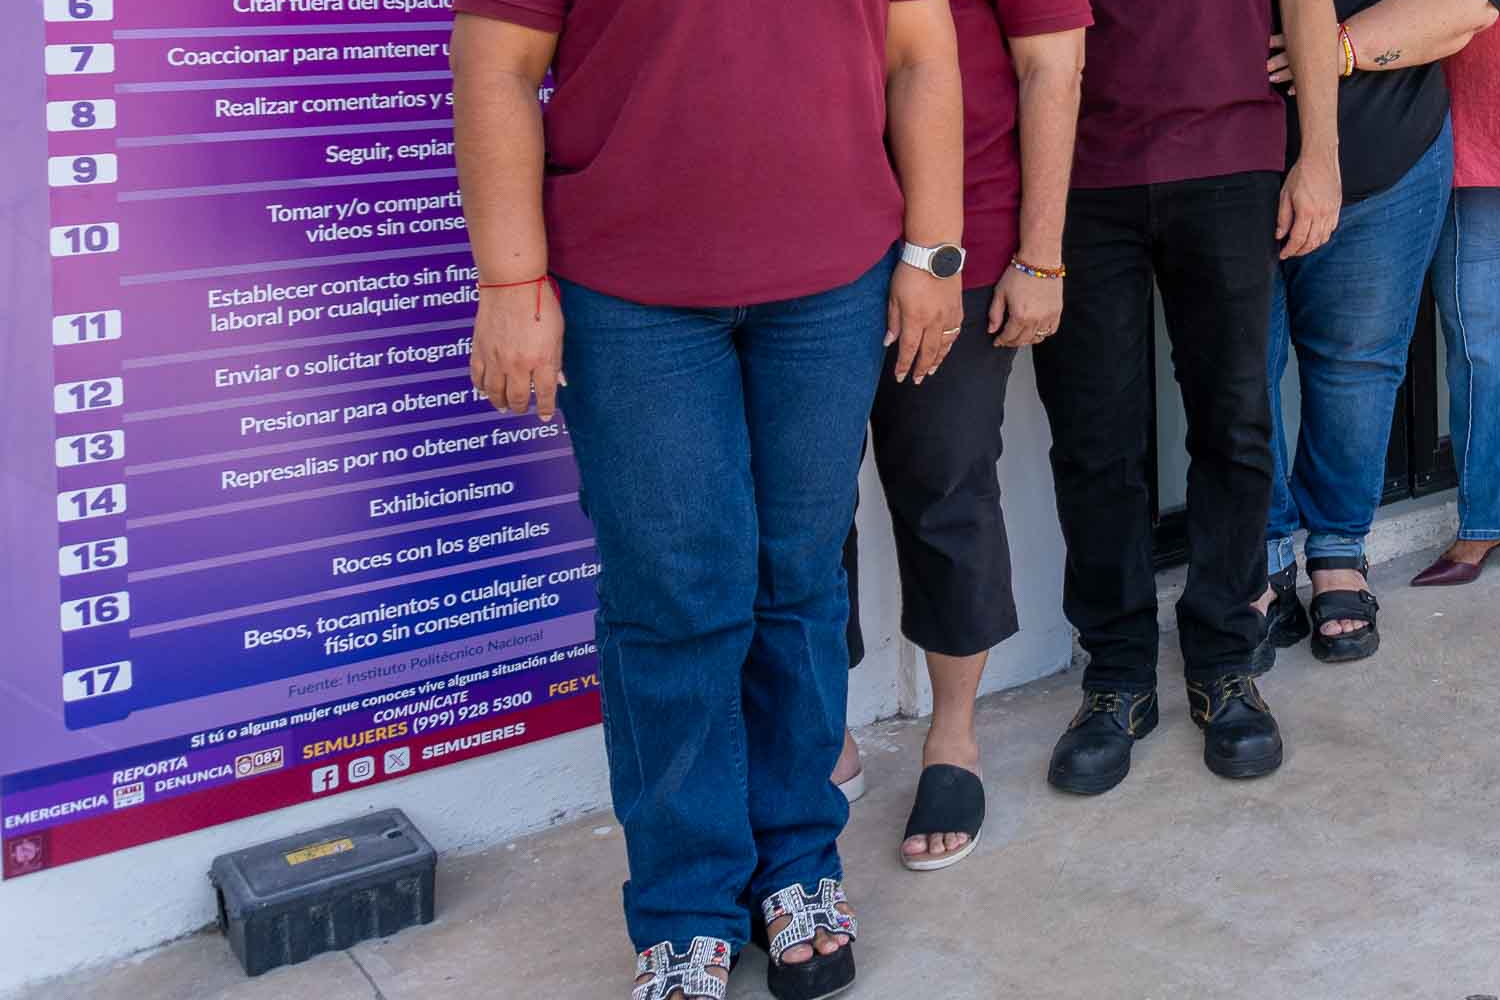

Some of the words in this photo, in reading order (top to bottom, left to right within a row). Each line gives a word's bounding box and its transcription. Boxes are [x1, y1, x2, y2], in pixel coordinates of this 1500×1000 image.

[70, 45, 94, 72] 7
[167, 44, 290, 67] Coaccionar
[292, 45, 338, 65] para
[342, 41, 437, 61] mantener
[71, 101, 96, 128] 8
[215, 96, 298, 118] Realizar
[302, 89, 427, 113] comentarios
[72, 156, 97, 183] 9
[325, 143, 394, 165] Seguir,
[267, 202, 333, 223] Tomar
[336, 198, 370, 222] y/o
[63, 225, 110, 253] 10
[306, 222, 373, 244] videos
[377, 219, 405, 237] sin
[207, 281, 317, 309] Establecer
[321, 270, 409, 296] contacto
[413, 267, 442, 285] sin
[69, 313, 107, 341] 11
[210, 305, 283, 332] laboral
[288, 305, 324, 327] por
[328, 293, 419, 318] cualquier
[215, 364, 282, 388] Enviar
[304, 349, 383, 376] solicitar
[68, 381, 113, 409] 12
[240, 407, 339, 435] Presionar
[343, 402, 387, 425] para
[392, 387, 469, 414] obtener
[69, 433, 115, 463] 13
[221, 456, 338, 489] Represalias
[343, 450, 379, 474] por
[412, 433, 489, 458] obtener
[491, 421, 559, 446] favores
[70, 486, 117, 517] 14
[369, 479, 515, 518] Exhibicionismo
[72, 540, 118, 570] 15
[332, 552, 392, 576] Roces
[396, 544, 433, 565] con
[436, 535, 465, 556] los
[468, 521, 550, 552] genitales
[74, 595, 120, 626] 16
[243, 621, 312, 650] Besos,
[316, 598, 440, 635] tocamientos
[460, 573, 546, 605] cualquier
[324, 631, 379, 656] físico
[382, 623, 411, 645] sin
[414, 592, 560, 636] consentimiento
[288, 677, 344, 698] Fuente:
[347, 661, 407, 686] Instituto
[409, 643, 484, 671] Politécnico
[487, 629, 544, 652] Nacional
[77, 666, 122, 698] 17
[240, 718, 288, 738] alguna
[290, 705, 331, 726] mujer
[333, 701, 360, 718] que
[361, 688, 417, 709] conoces
[418, 680, 446, 695] vive
[447, 671, 490, 691] alguna
[491, 656, 547, 678] situación
[548, 676, 578, 698] FGE
[373, 690, 469, 725] COMUNÍCATE
[302, 721, 409, 760] SEMUJERES
[411, 709, 455, 735] (999)
[458, 701, 489, 720] 928
[492, 690, 533, 712] 5300
[421, 723, 526, 760] SEMUJERES
[112, 756, 189, 786] REPORTA
[154, 764, 233, 793] DENUNCIA
[254, 750, 281, 766] 089
[4, 794, 109, 830] EMERGENCIA
